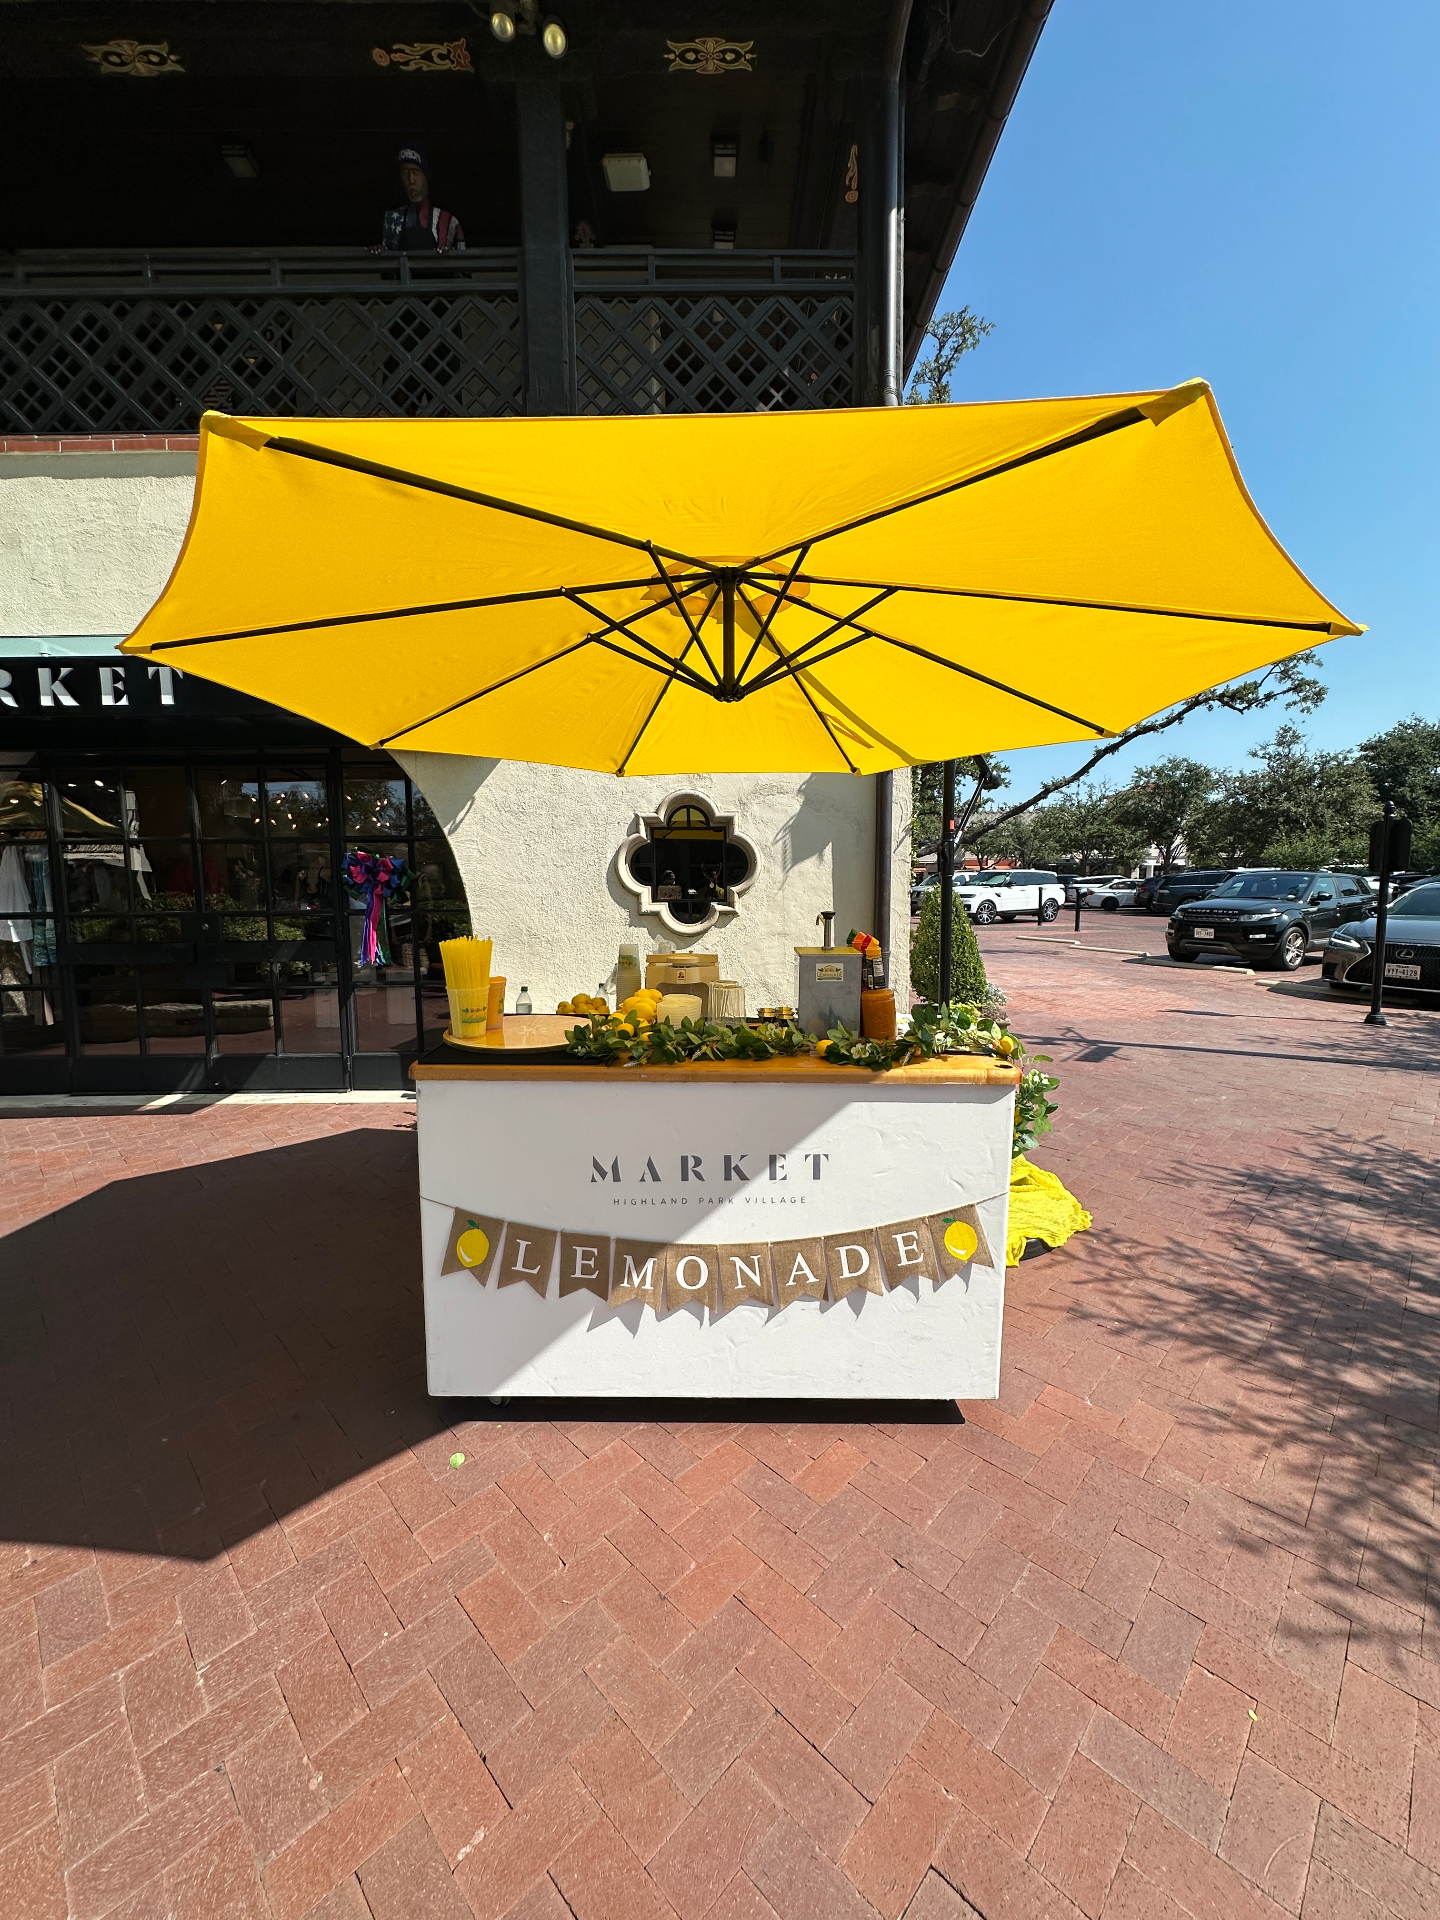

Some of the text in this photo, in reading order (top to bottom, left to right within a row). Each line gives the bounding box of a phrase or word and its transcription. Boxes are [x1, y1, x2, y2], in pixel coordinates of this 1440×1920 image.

[590, 1153, 830, 1183] MARKET
[613, 1196, 807, 1206] HIGHLAND PARK VILLAGE
[510, 1230, 924, 1290] LEMONADE
